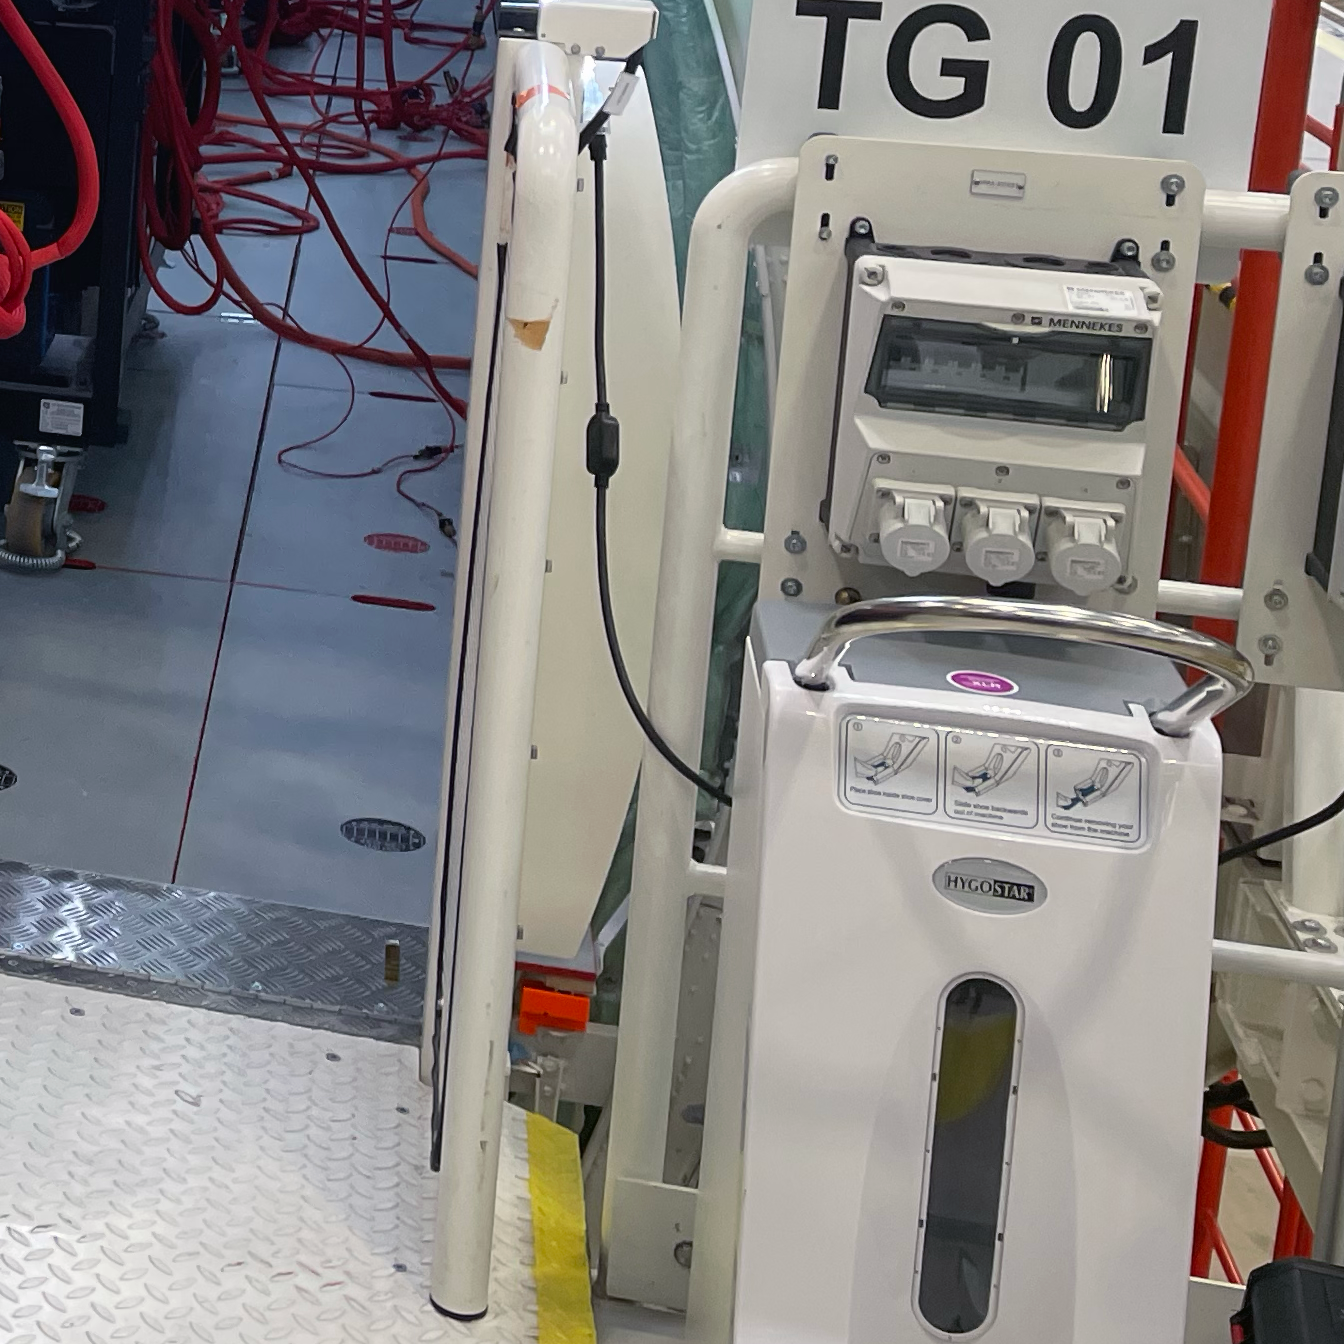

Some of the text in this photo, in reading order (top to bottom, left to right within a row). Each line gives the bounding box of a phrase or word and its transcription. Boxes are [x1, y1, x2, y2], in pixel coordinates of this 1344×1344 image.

[1045, 13, 1200, 135] 01
[1048, 317, 1123, 333] MENNEKES
[947, 874, 1029, 901] HYGOSTAR
